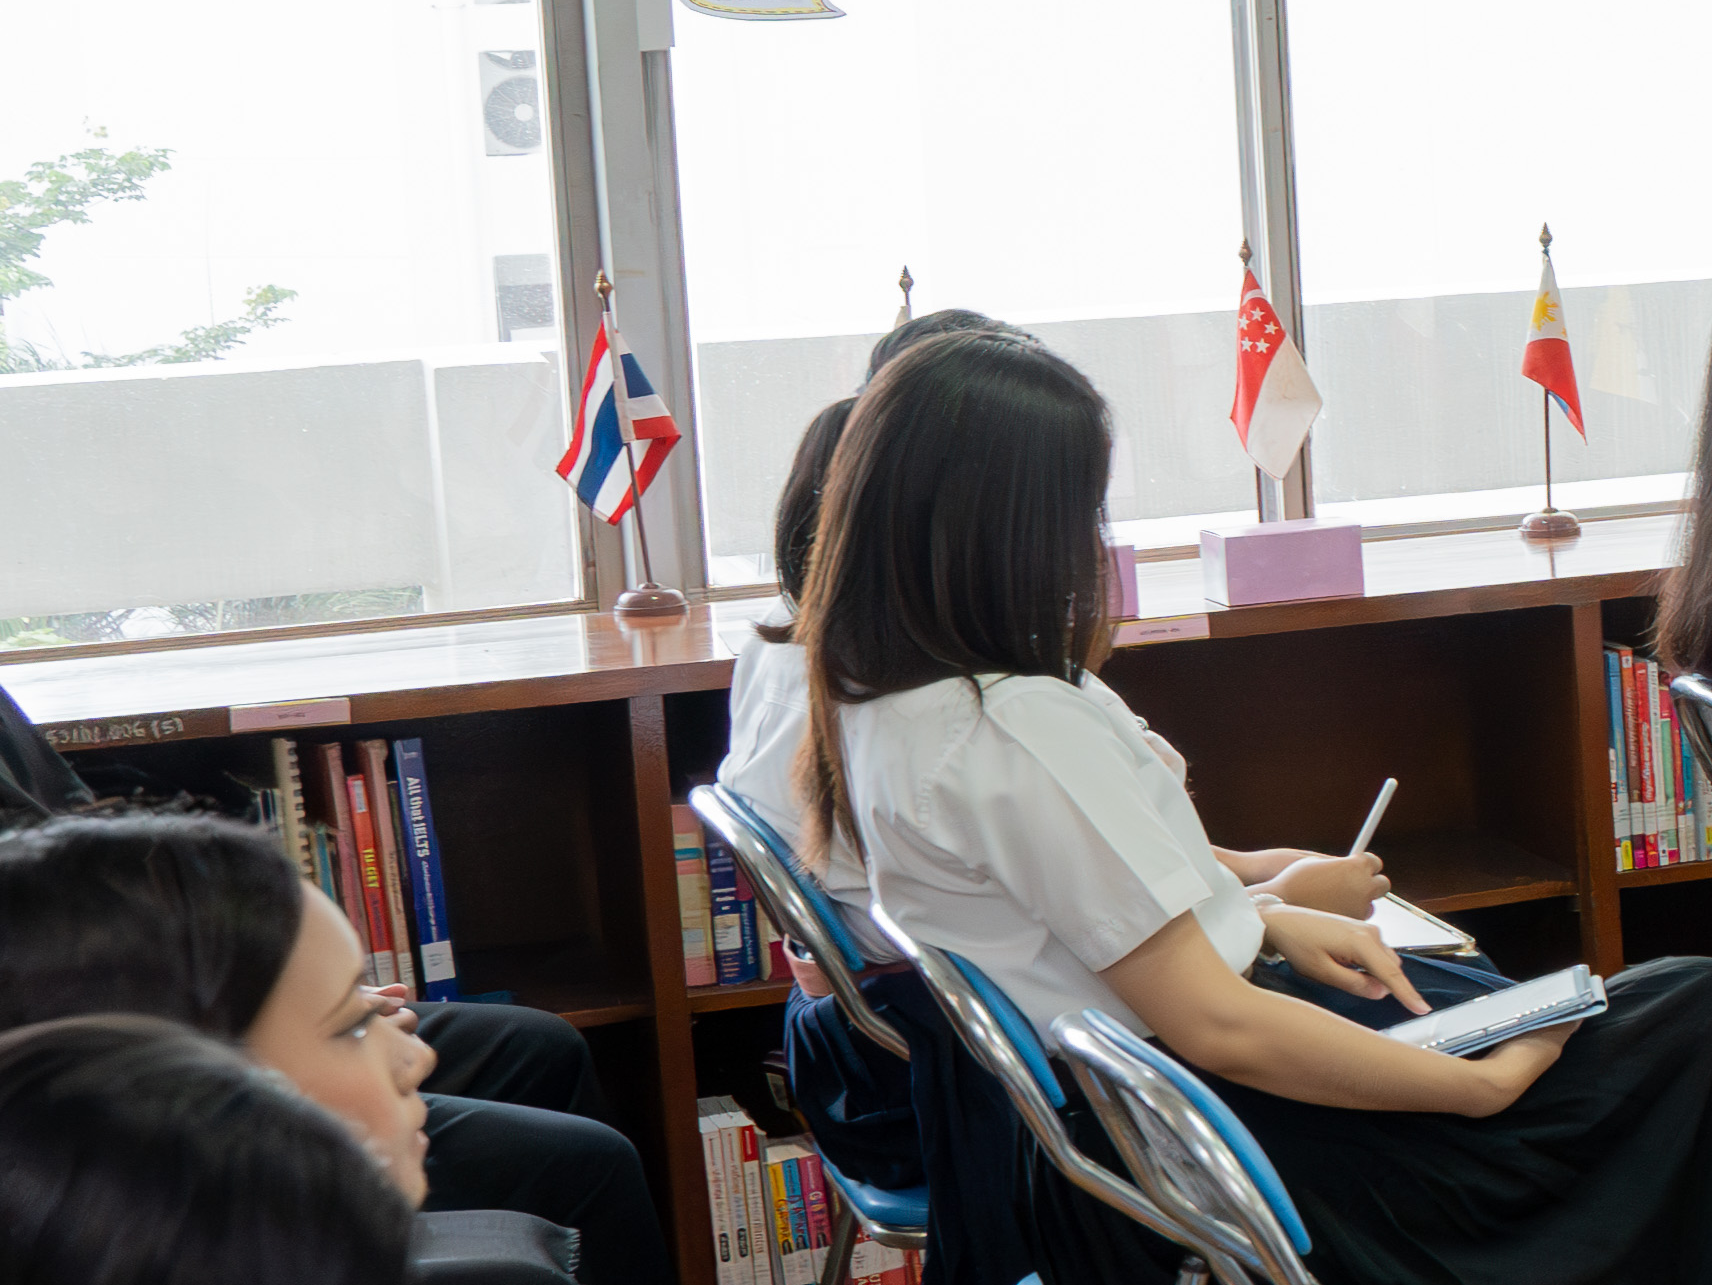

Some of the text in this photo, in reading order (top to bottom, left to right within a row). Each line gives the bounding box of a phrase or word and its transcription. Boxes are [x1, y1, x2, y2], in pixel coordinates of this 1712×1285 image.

[406, 777, 421, 795] All
[409, 796, 425, 821] that
[412, 822, 430, 858] IELTS
